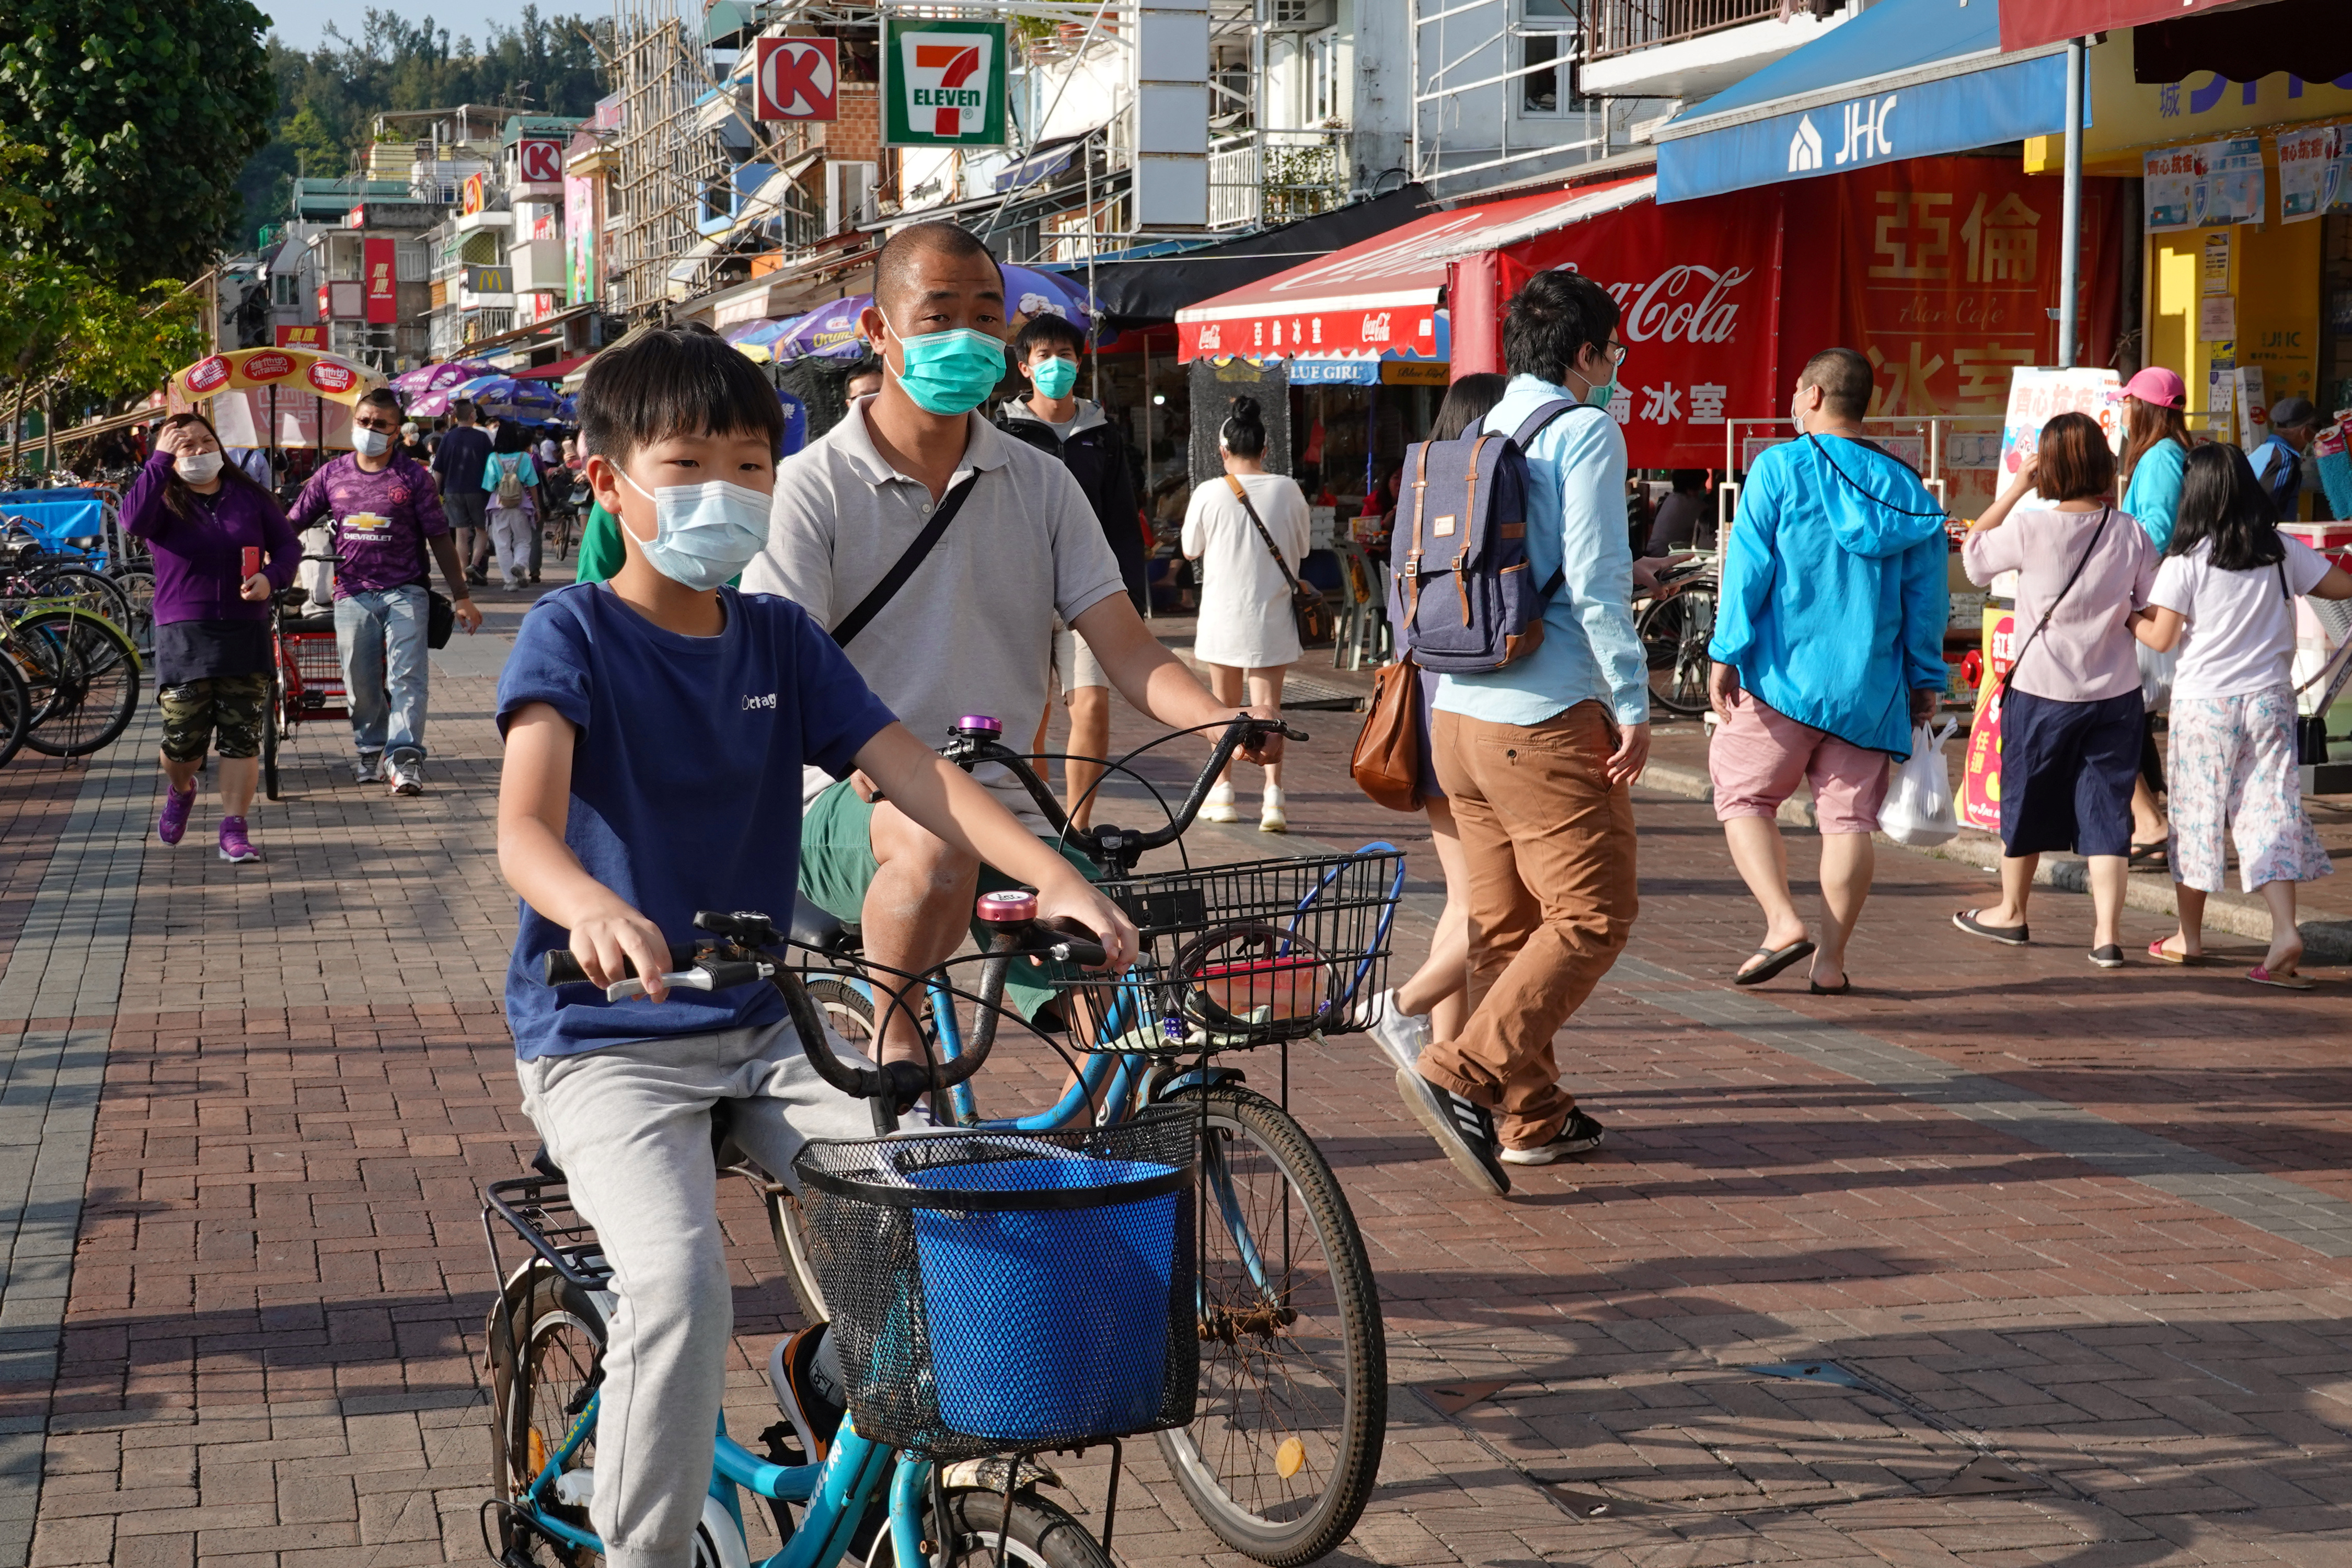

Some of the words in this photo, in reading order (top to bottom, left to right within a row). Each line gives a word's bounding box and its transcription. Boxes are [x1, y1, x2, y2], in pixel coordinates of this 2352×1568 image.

[776, 49, 827, 113] K
[916, 45, 979, 135] 7
[914, 89, 981, 107] ELEVEN
[1835, 95, 1897, 165] JHC
[529, 145, 557, 177] K
[1869, 190, 2042, 283] 亞倫
[1199, 324, 1220, 349] Coca-Cola
[1362, 312, 1391, 342] Coca-Cola
[1289, 366, 1322, 379] LUE
[1323, 365, 1361, 379] GIRL
[1397, 367, 1423, 378] Blue
[1425, 367, 1448, 379] Girl
[344, 533, 393, 542] CHEVROLET
[1971, 730, 1990, 774] 任選
